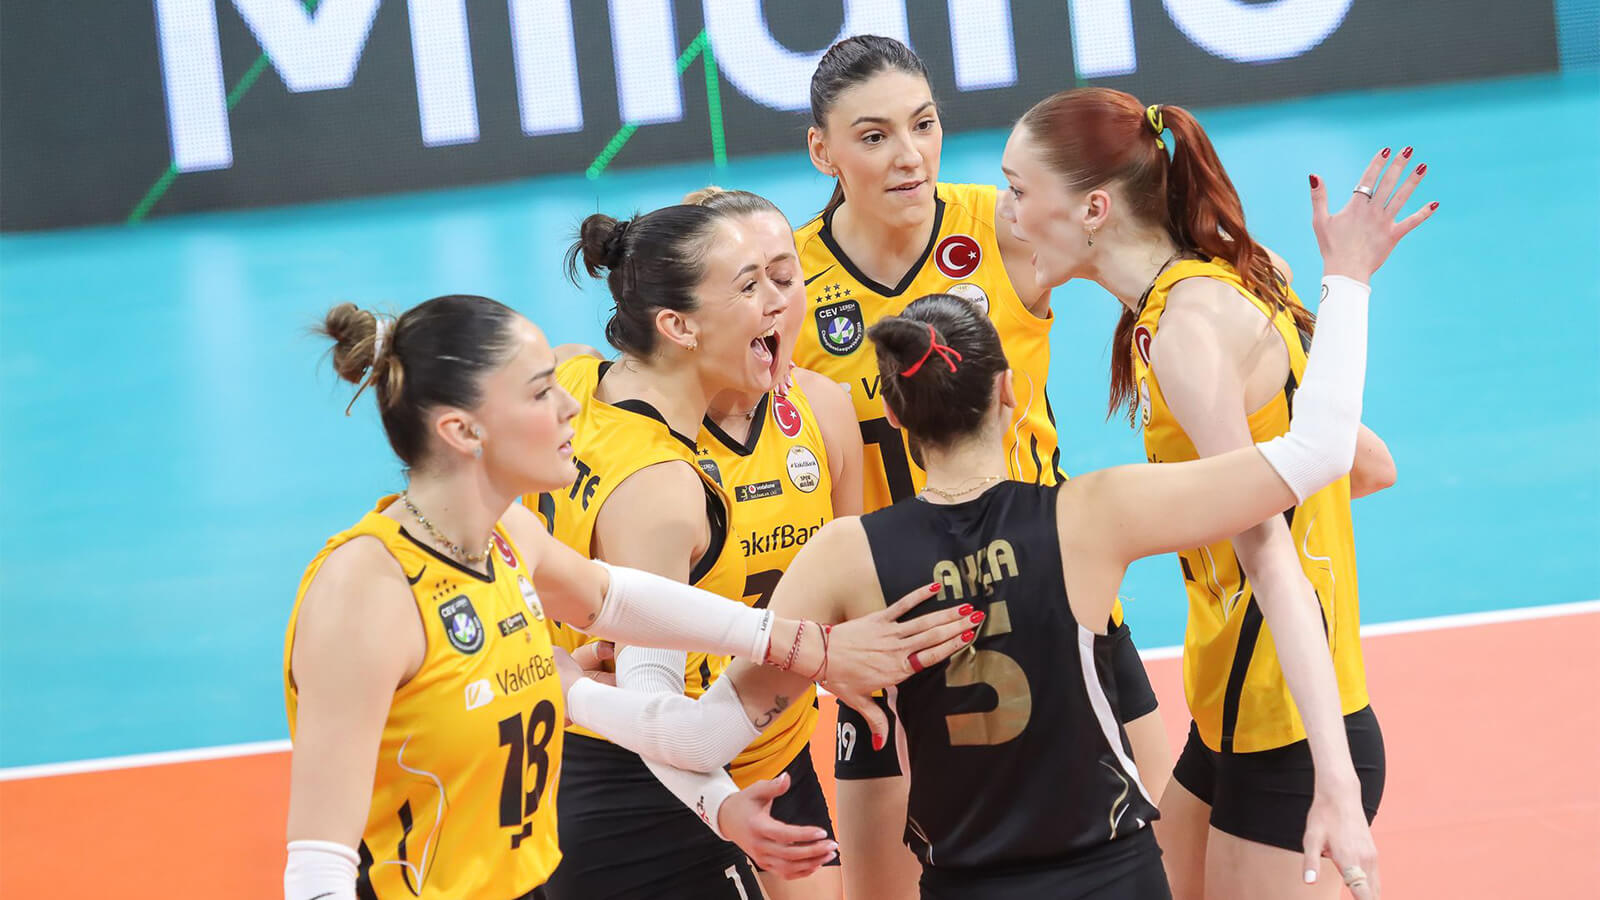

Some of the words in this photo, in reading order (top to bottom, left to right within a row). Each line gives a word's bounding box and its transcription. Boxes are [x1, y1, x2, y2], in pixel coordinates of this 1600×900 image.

[819, 307, 838, 319] CEV
[740, 517, 824, 557] akıfBan
[945, 599, 1032, 746] 5
[837, 721, 857, 761] 19
[498, 699, 556, 828] 18
